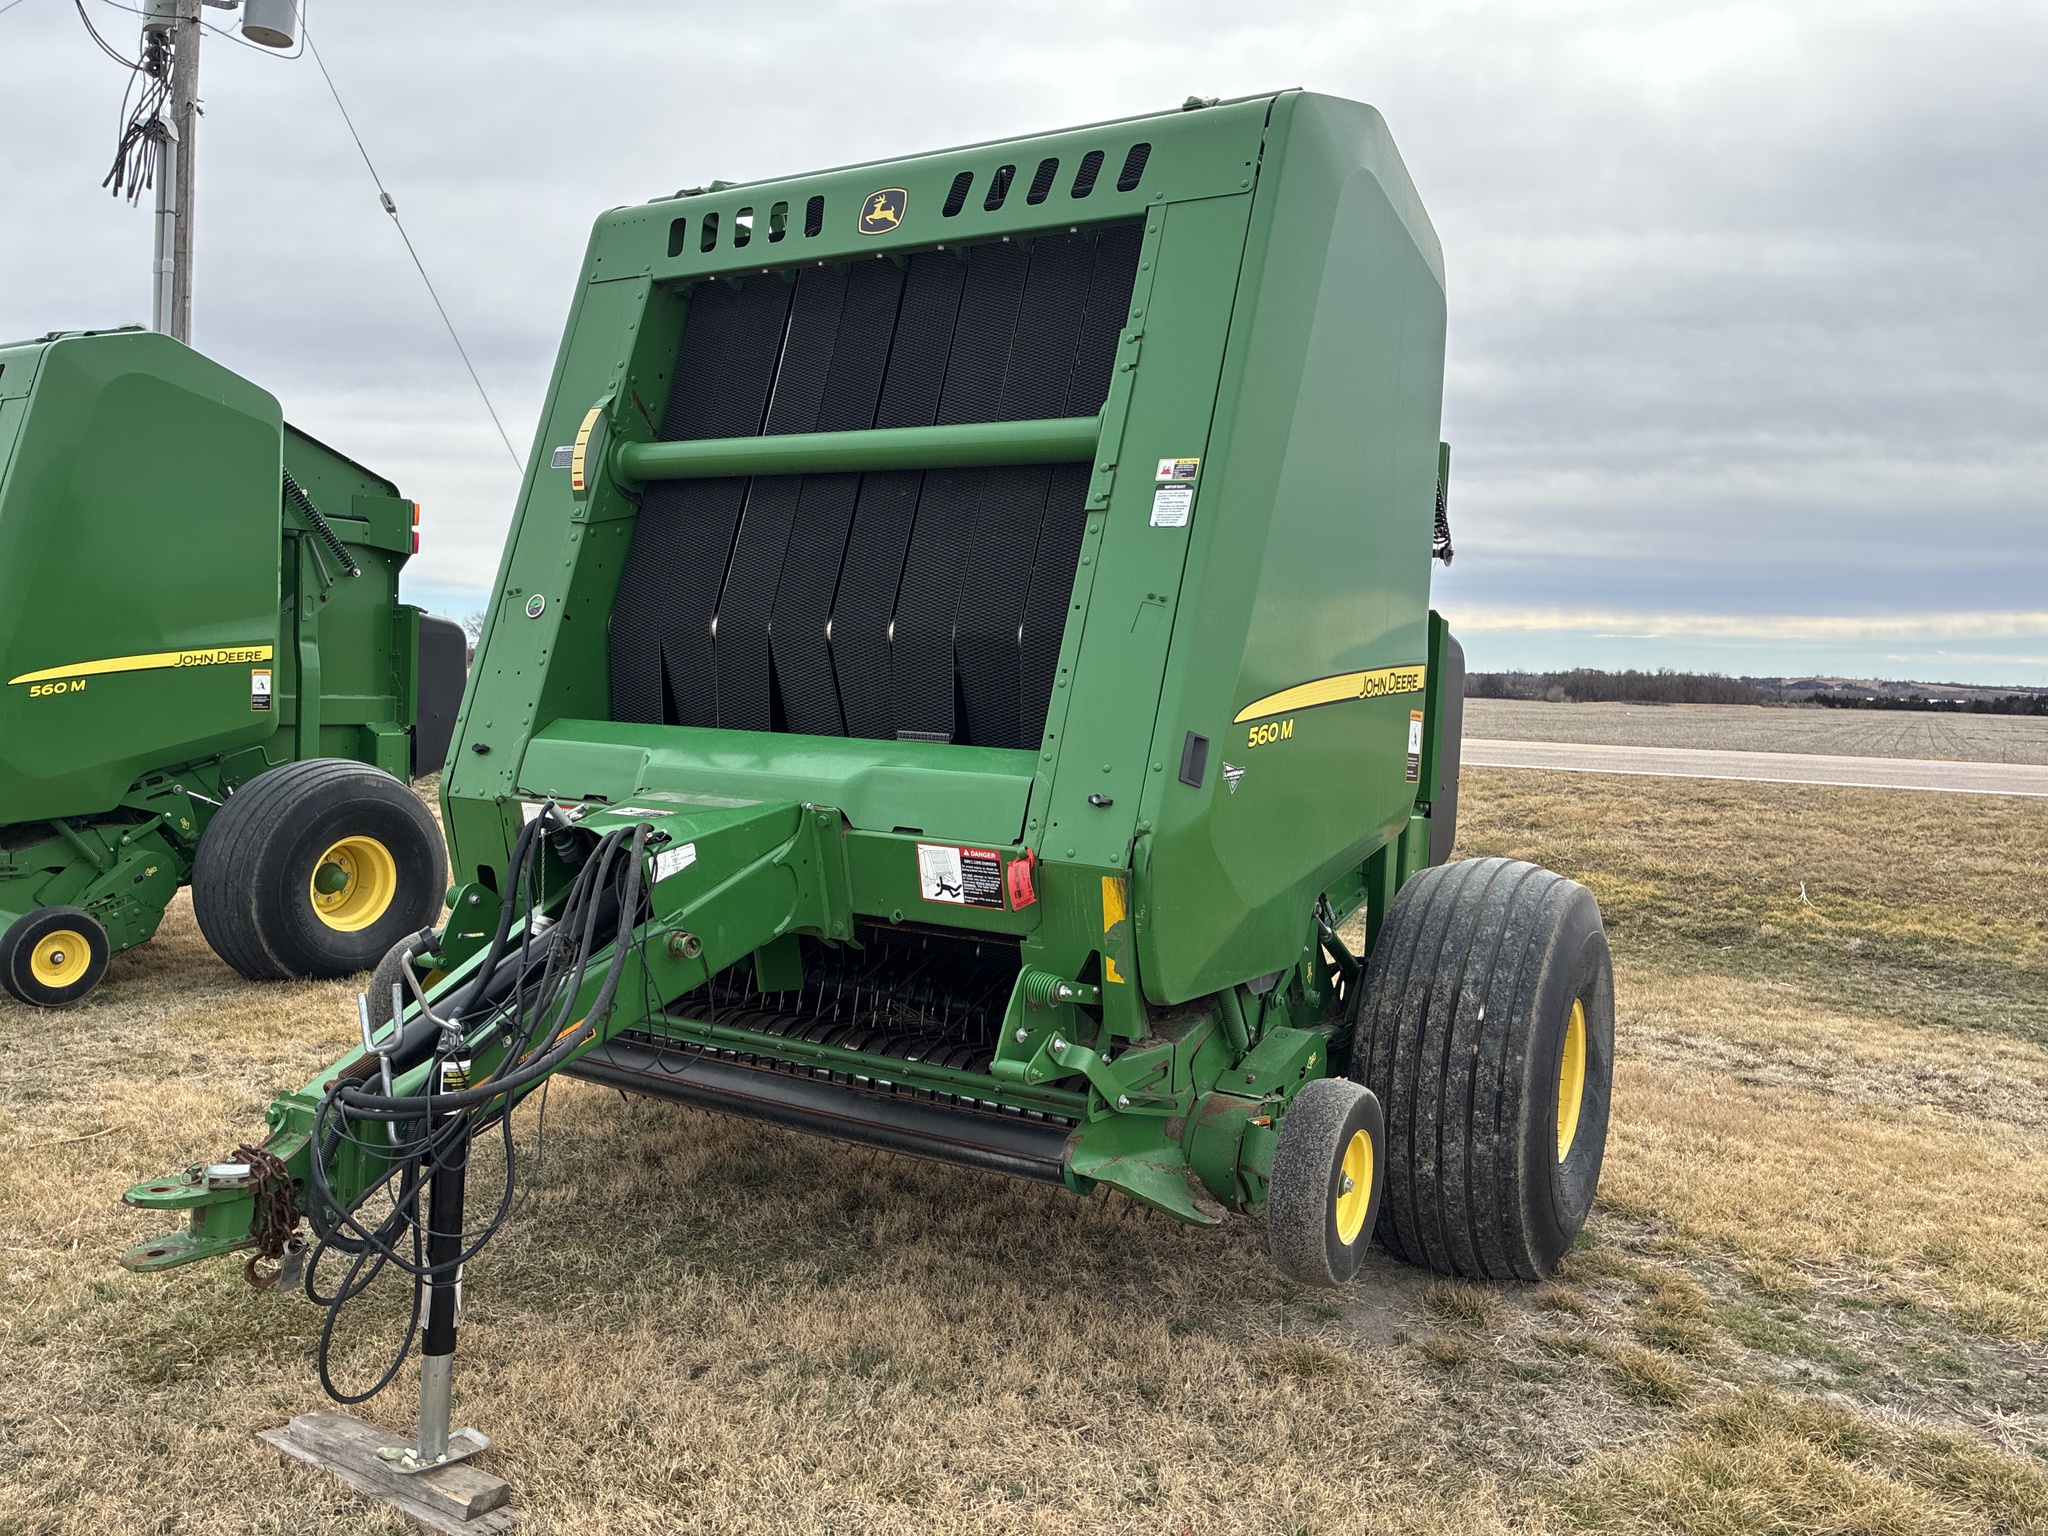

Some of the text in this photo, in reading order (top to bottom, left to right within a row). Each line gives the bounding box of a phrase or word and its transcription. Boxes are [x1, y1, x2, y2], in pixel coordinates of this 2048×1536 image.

[174, 650, 262, 666] JOHN DEERE
[29, 679, 87, 698] 560 M
[1360, 672, 1418, 696] JOHN DEERE
[1248, 718, 1294, 748] 560 M
[970, 850, 996, 859] DANGER
